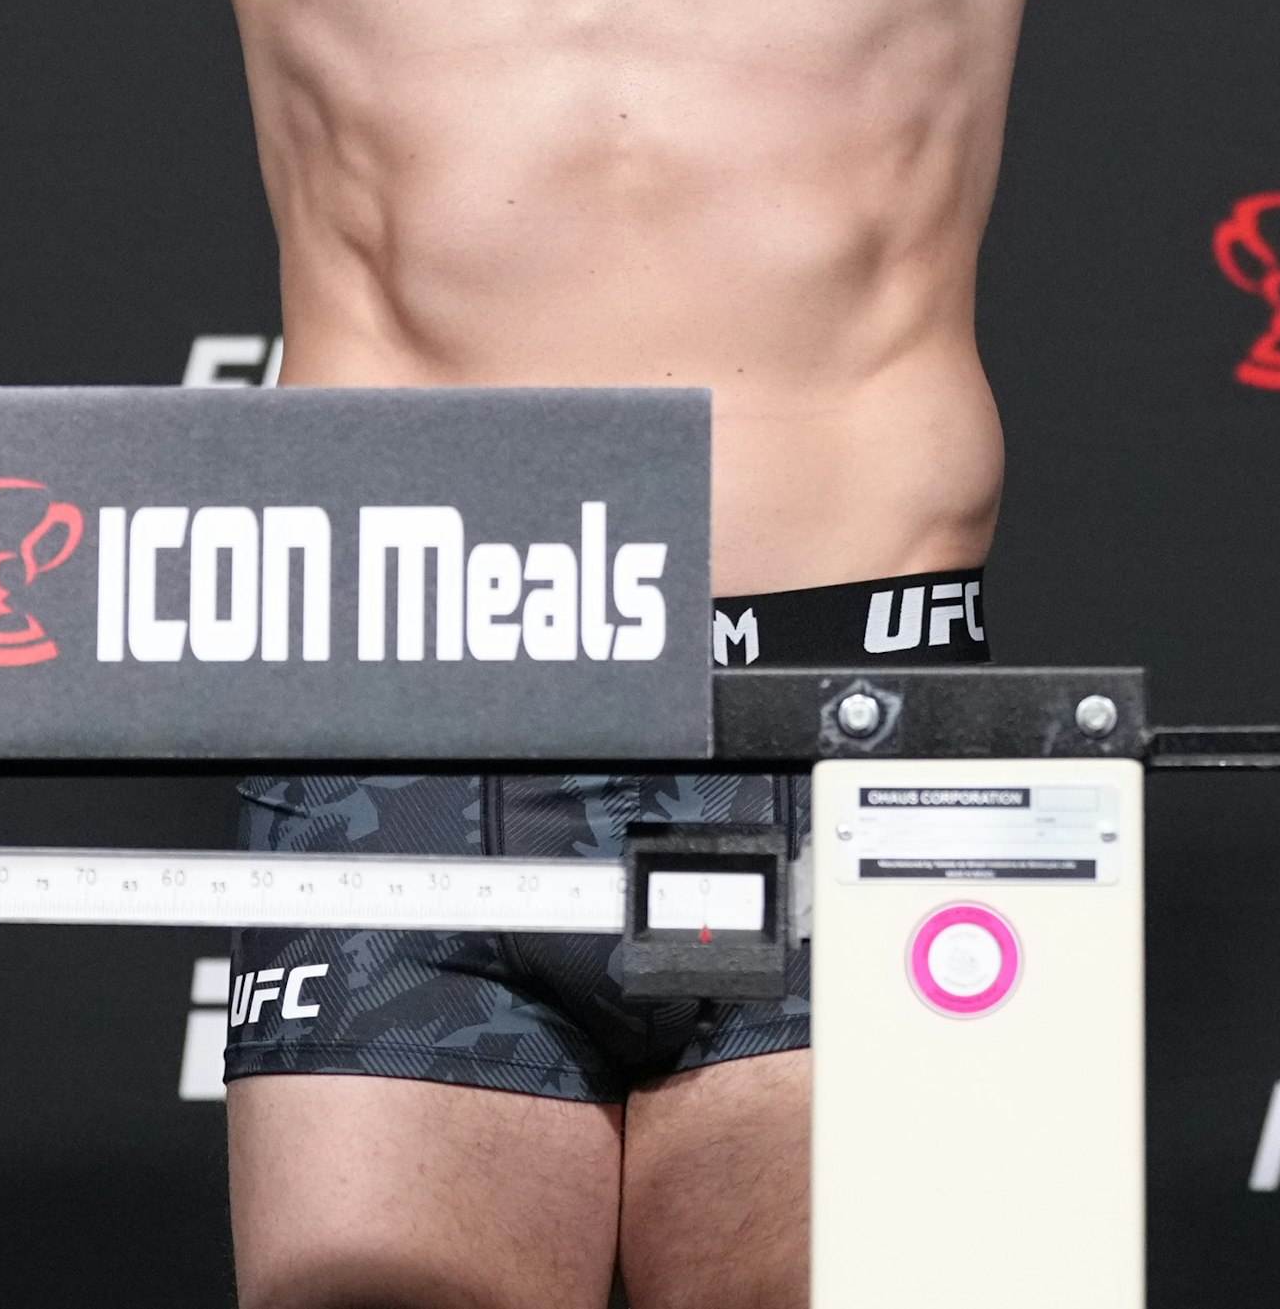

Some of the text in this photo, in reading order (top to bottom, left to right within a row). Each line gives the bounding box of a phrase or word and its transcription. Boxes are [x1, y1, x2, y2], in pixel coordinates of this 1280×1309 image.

[96, 500, 669, 662] ICON Meals
[867, 789, 1023, 806] OHAUS CORPORATION
[74, 866, 97, 886] 70
[161, 868, 185, 887] 60
[250, 871, 273, 888] 50
[339, 872, 362, 889] 40
[427, 873, 451, 891] 30
[517, 875, 540, 893] 20
[230, 963, 329, 1027] UFC
